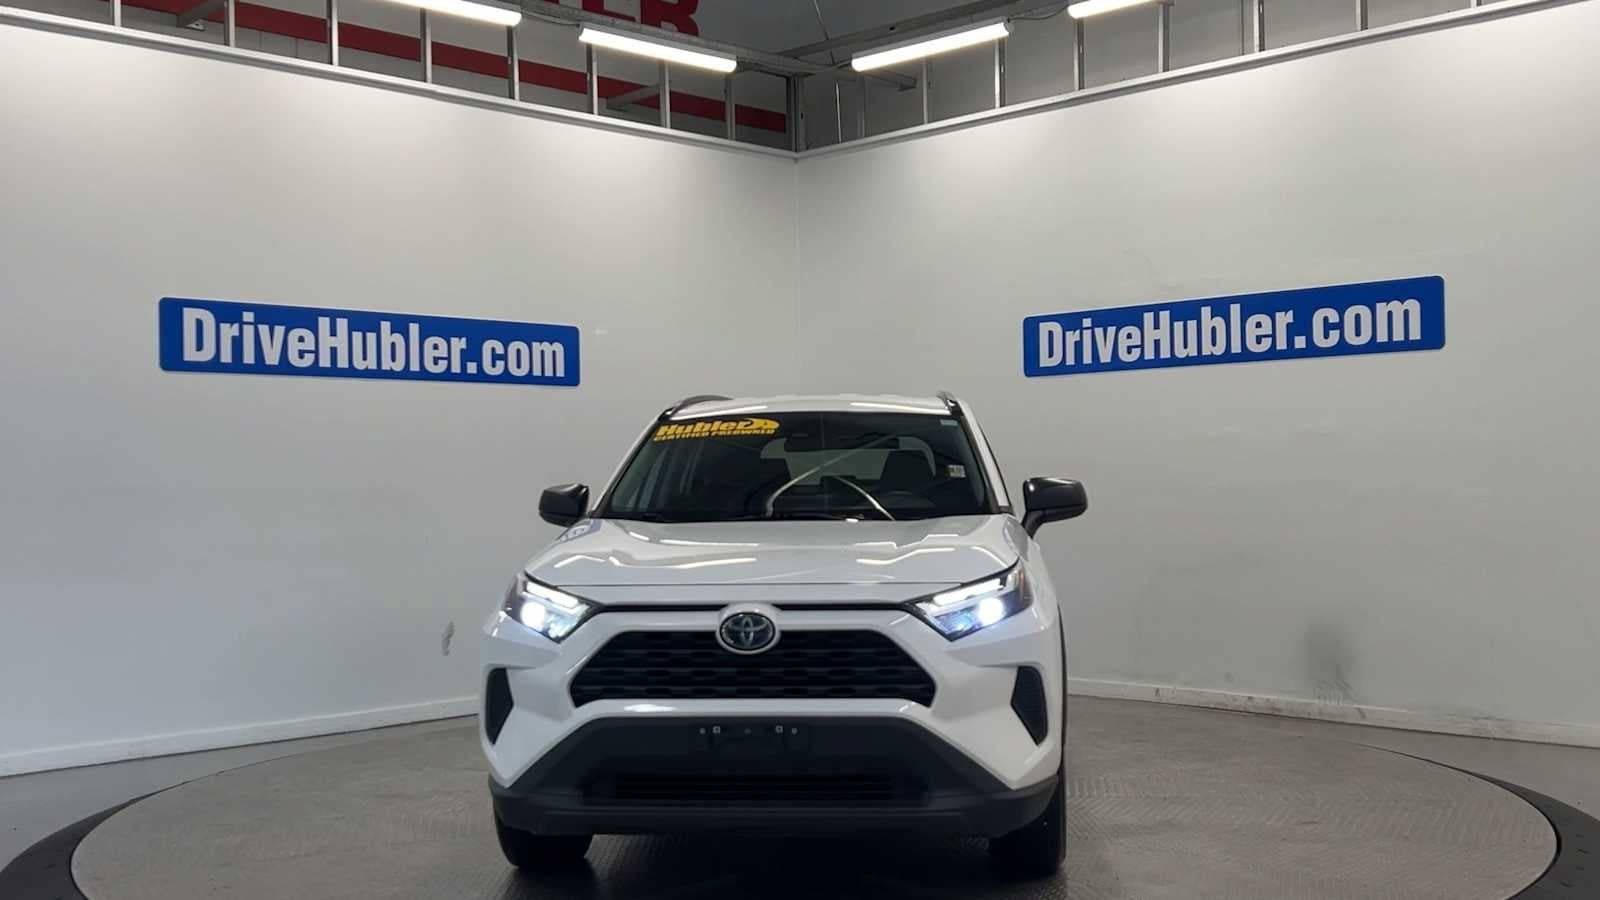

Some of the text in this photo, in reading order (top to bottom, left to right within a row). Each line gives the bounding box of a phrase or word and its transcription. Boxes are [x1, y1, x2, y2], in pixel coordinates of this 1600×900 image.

[183, 307, 565, 377] DriveHubler.com
[1039, 298, 1421, 368] DriveHubler.com
[656, 420, 754, 437] Hubler
